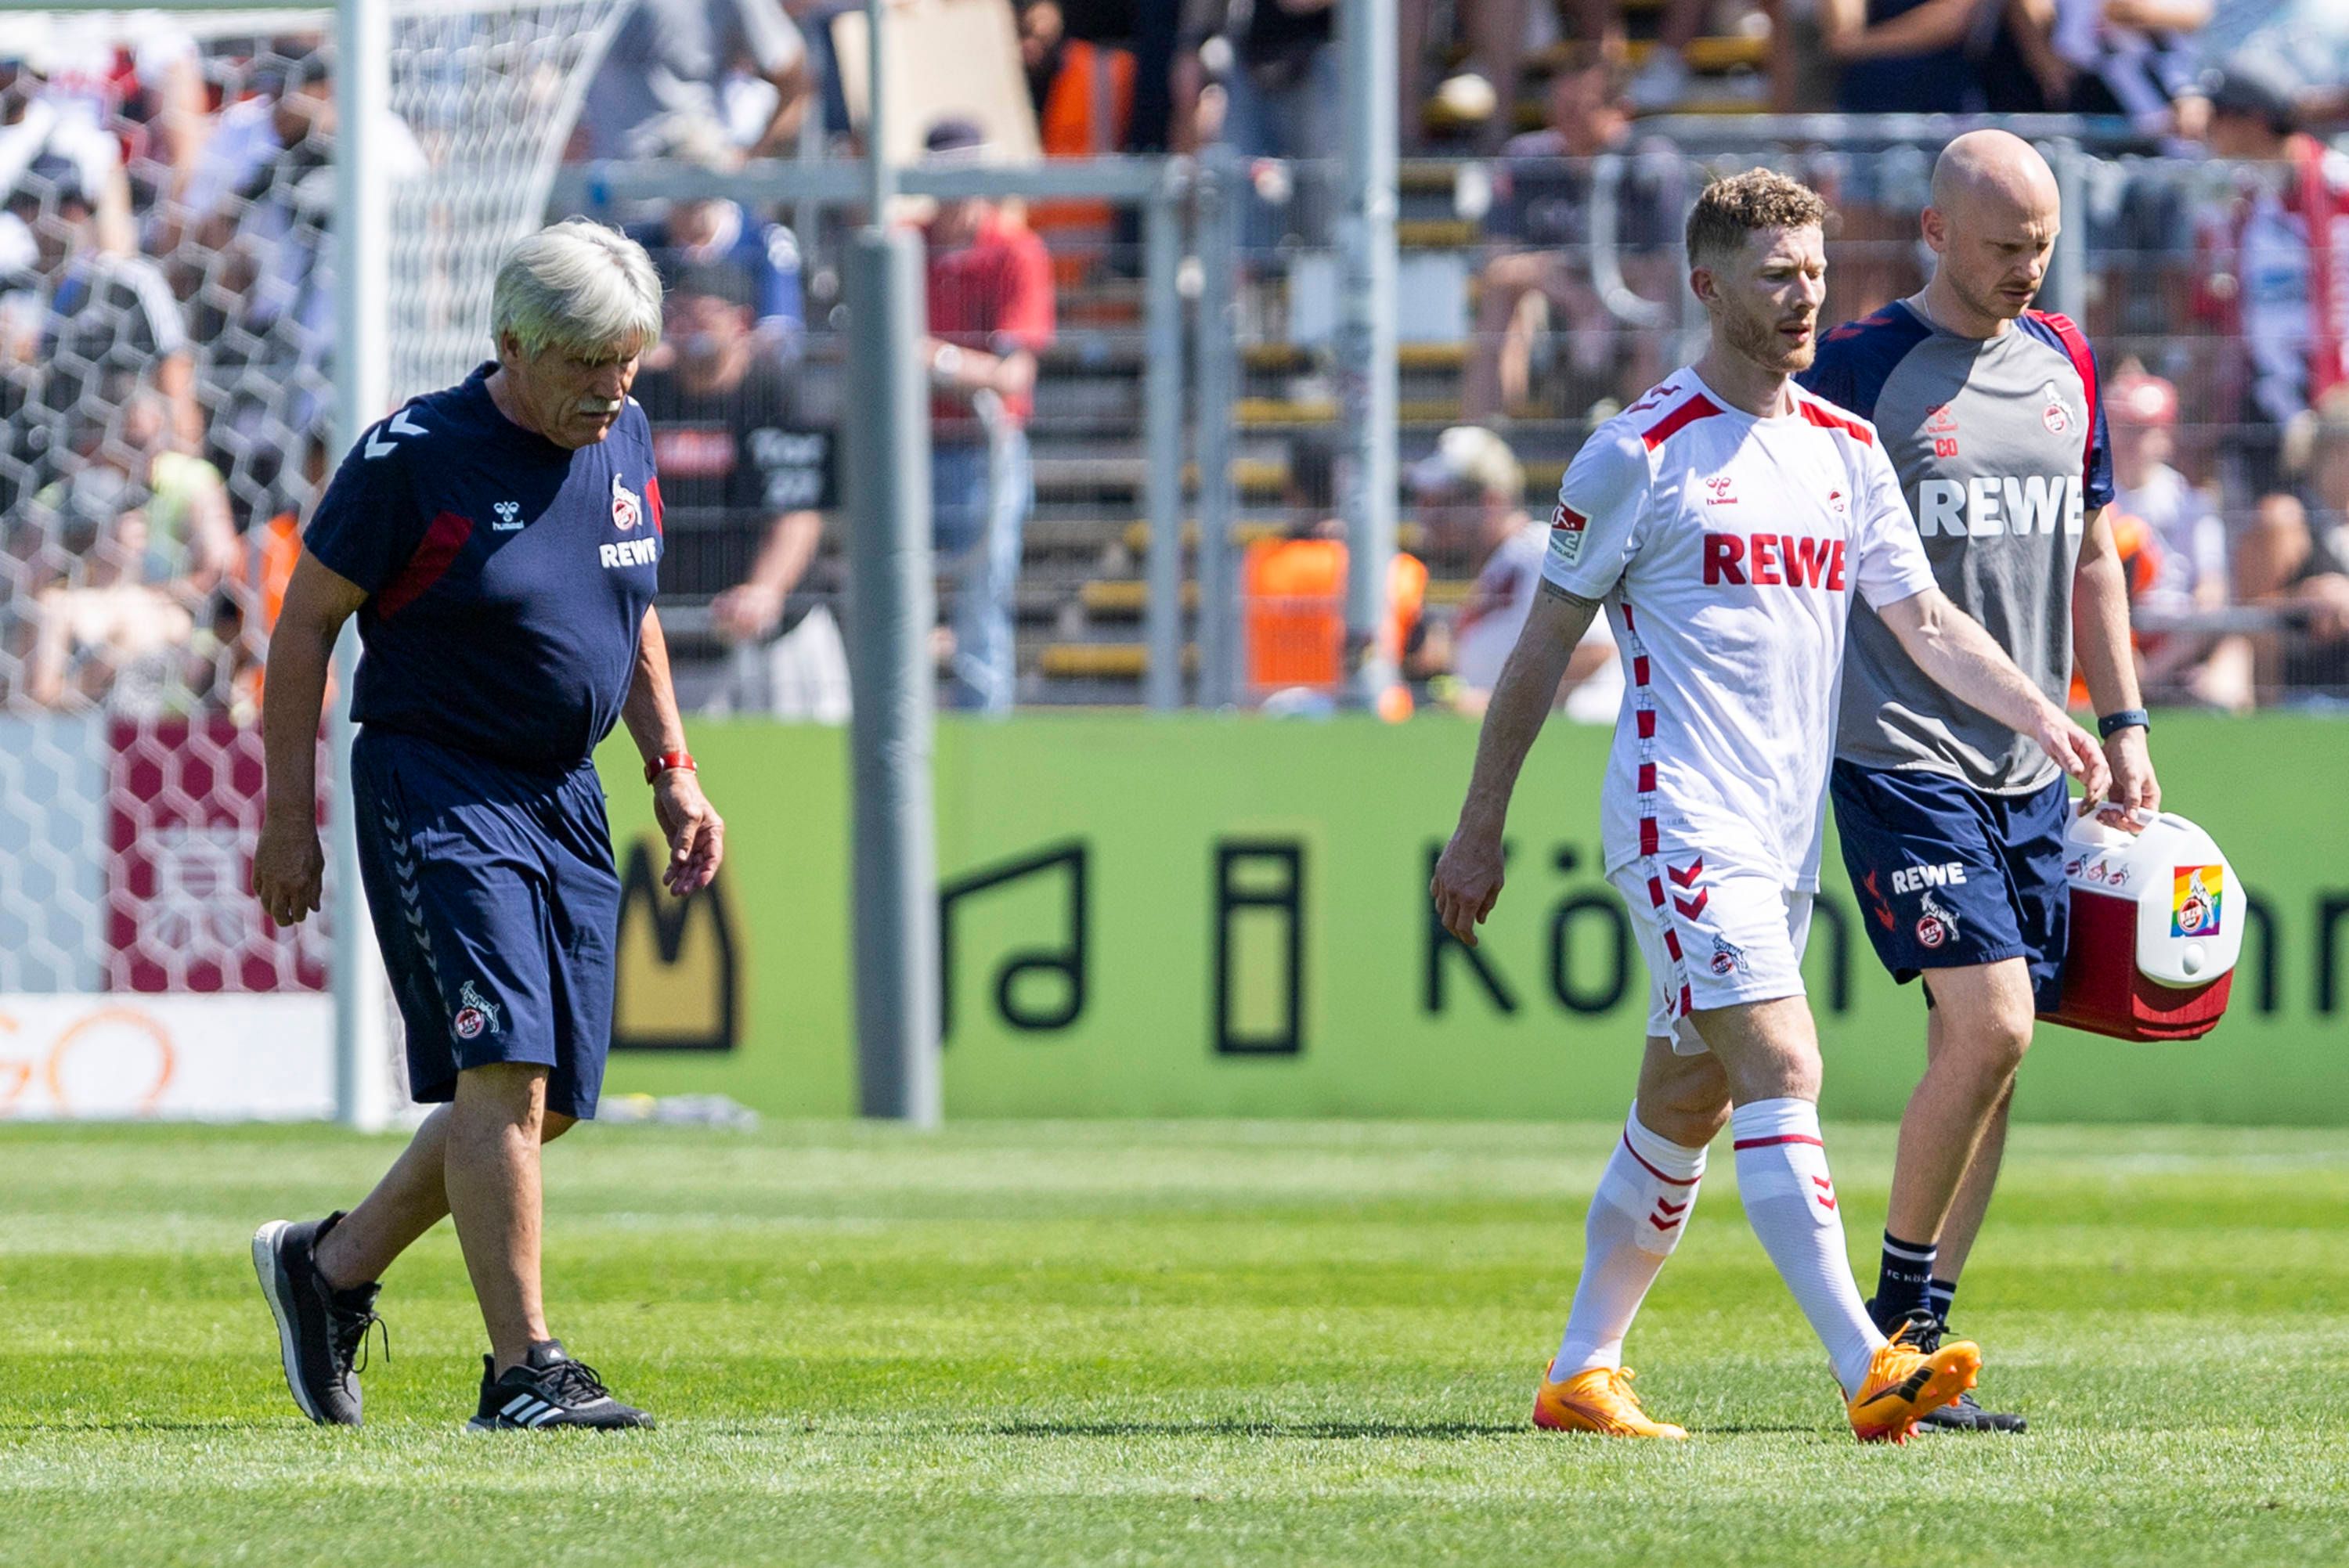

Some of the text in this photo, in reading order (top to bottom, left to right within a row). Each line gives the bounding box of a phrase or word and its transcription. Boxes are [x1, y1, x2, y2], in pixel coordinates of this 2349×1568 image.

[1919, 476, 2084, 537] REWE
[1703, 533, 1846, 591] REWE
[1892, 862, 1967, 895] REWE
